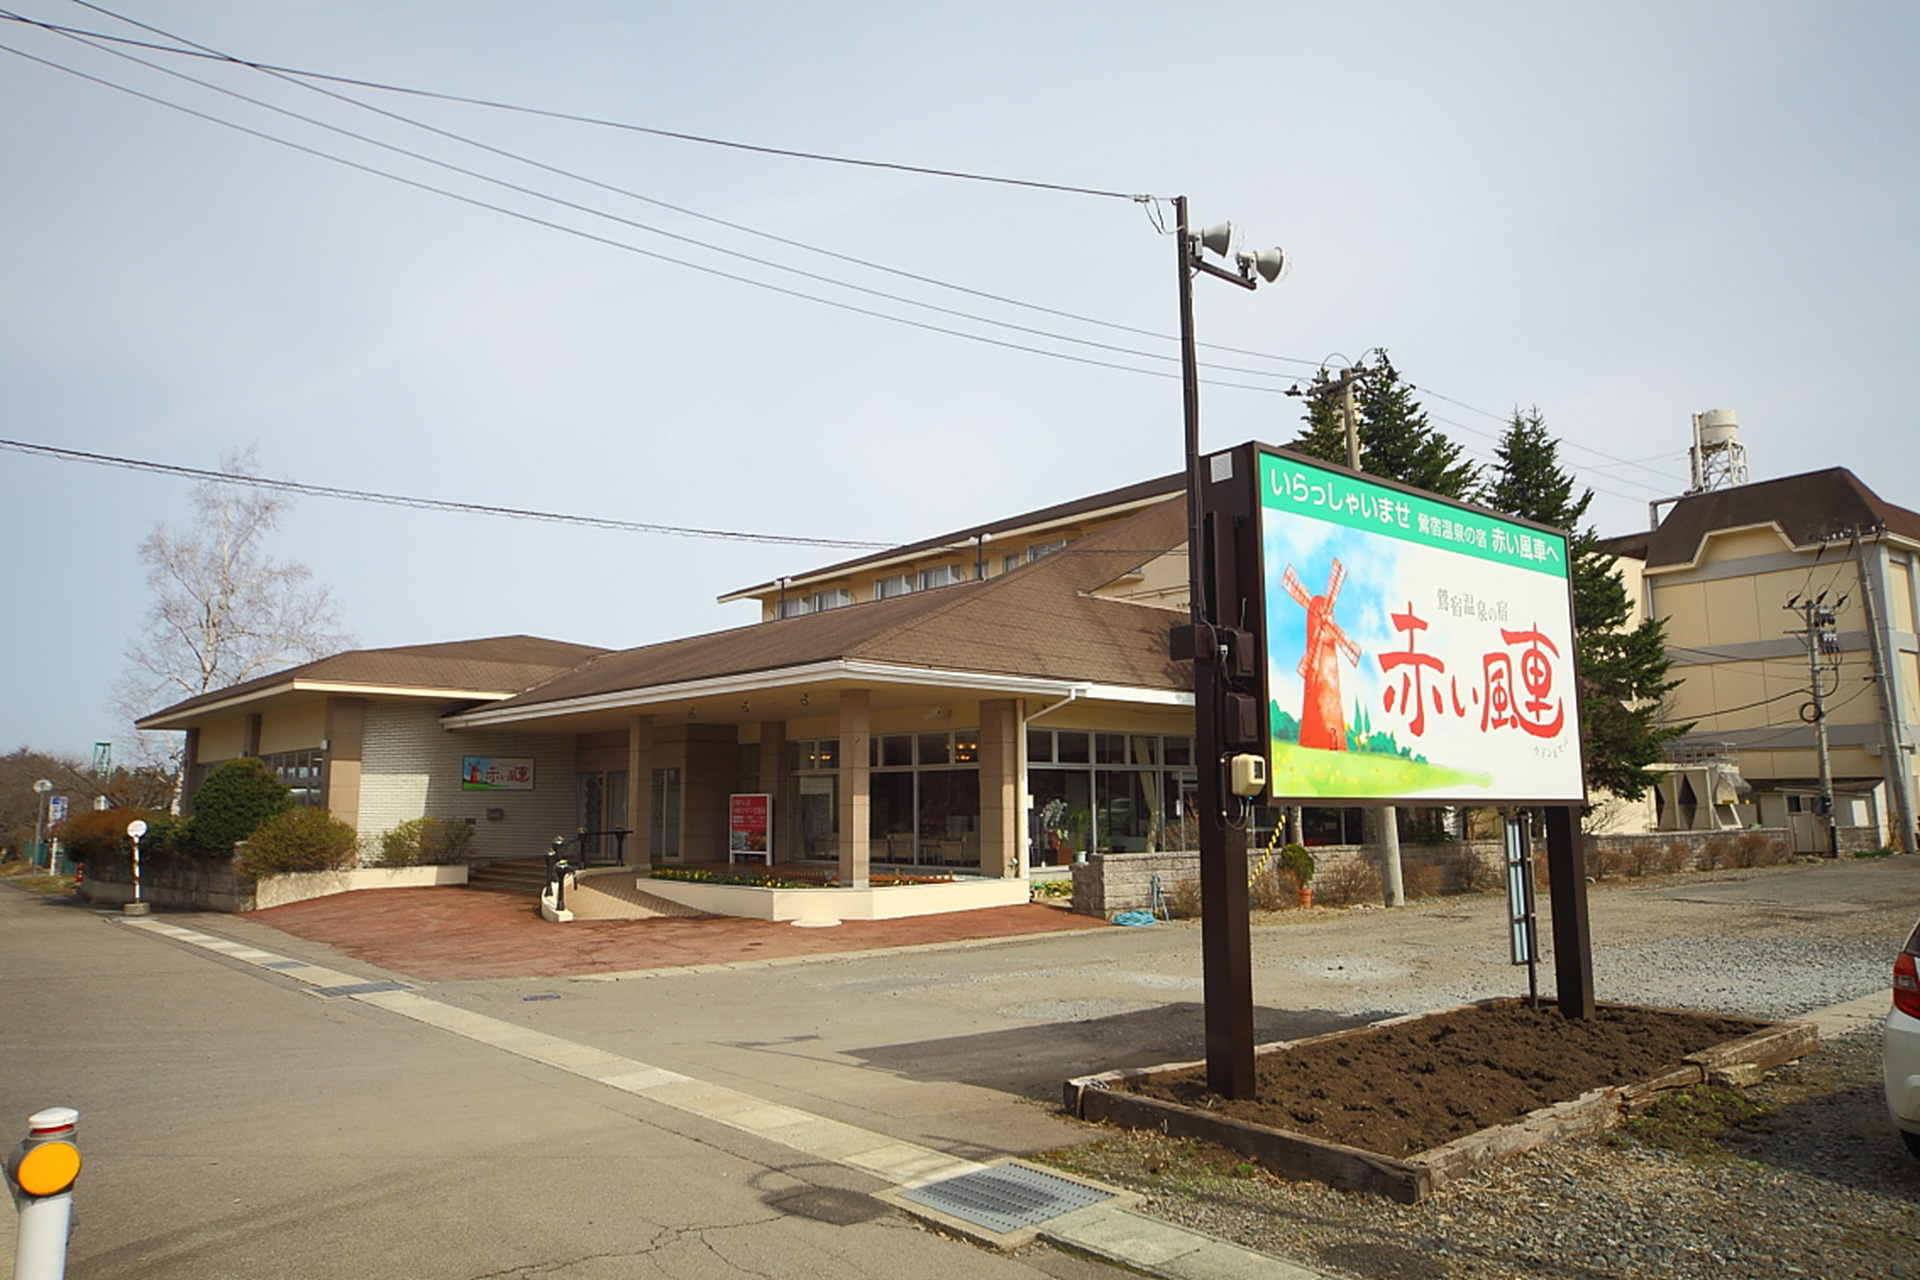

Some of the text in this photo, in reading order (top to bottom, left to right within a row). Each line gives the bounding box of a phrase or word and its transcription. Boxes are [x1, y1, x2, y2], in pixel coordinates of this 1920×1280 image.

[1270, 468, 1411, 529] いらっしゃいませ
[1491, 526, 1560, 562] 赤い風車へ
[1378, 600, 1564, 738] 赤い風車
